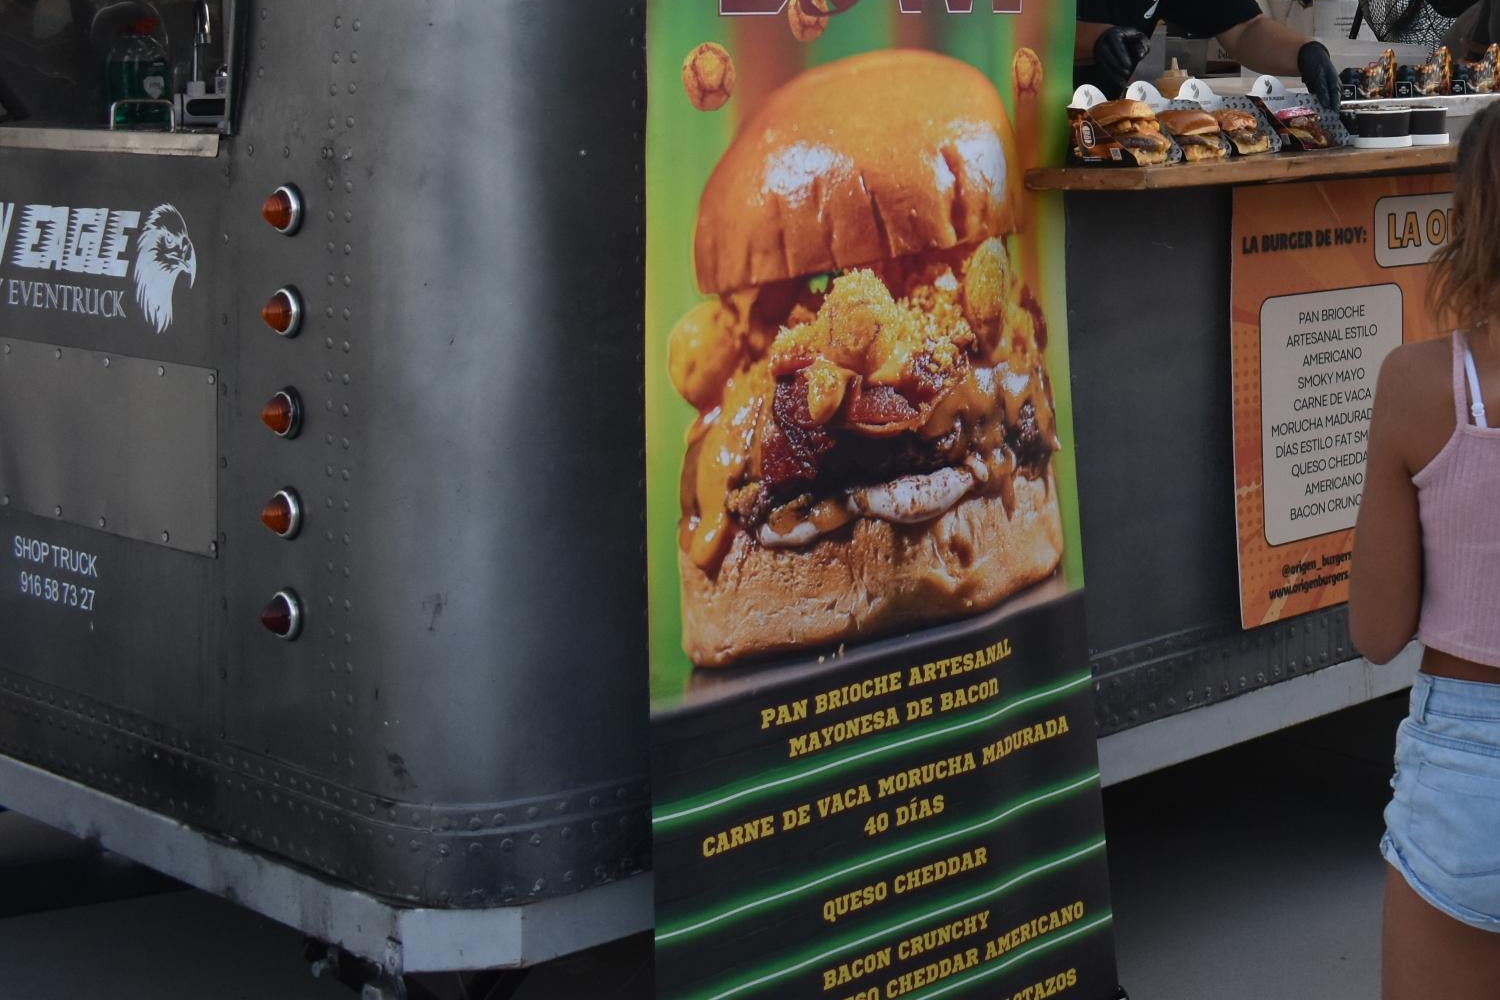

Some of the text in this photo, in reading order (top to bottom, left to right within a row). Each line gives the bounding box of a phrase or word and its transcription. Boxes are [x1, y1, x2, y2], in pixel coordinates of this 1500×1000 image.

[1242, 226, 1367, 255] LA BURGER DE HOY:
[1387, 211, 1421, 249] LA
[8, 279, 127, 318] EVENTRUCK
[1299, 304, 1366, 324] PAN BRIOCHE
[1286, 324, 1378, 348] ARTESANAL ESTILO
[1302, 347, 1362, 367] AMERICANO
[1298, 367, 1365, 389] SMOKY MAYO
[1293, 388, 1372, 412] CARNE DE VACA
[1271, 420, 1323, 437] MORUCHA
[1275, 442, 1299, 458] DÍAS
[1301, 436, 1333, 454] ESTILO
[1335, 433, 1352, 448] FAT
[1291, 459, 1327, 477] QUESO
[1304, 472, 1363, 496] AMERICANO
[1290, 502, 1326, 521] BACON
[14, 535, 98, 577] SHOP TRUCK
[20, 571, 95, 611] 916 58 73 27
[760, 638, 1012, 730] PAN BRIOCHE ARTESANAL
[788, 707, 900, 759] MAYONESA
[906, 697, 933, 721] DE
[701, 714, 1069, 858] CARNE DE VACA MORUCHA MADURADA
[863, 794, 945, 837] 40 DÍAS
[822, 846, 988, 923] QUESO CHEDDAR
[822, 910, 991, 991] BACON CRUNCHY
[885, 900, 1085, 999] CHEDDAR AMERICANO
